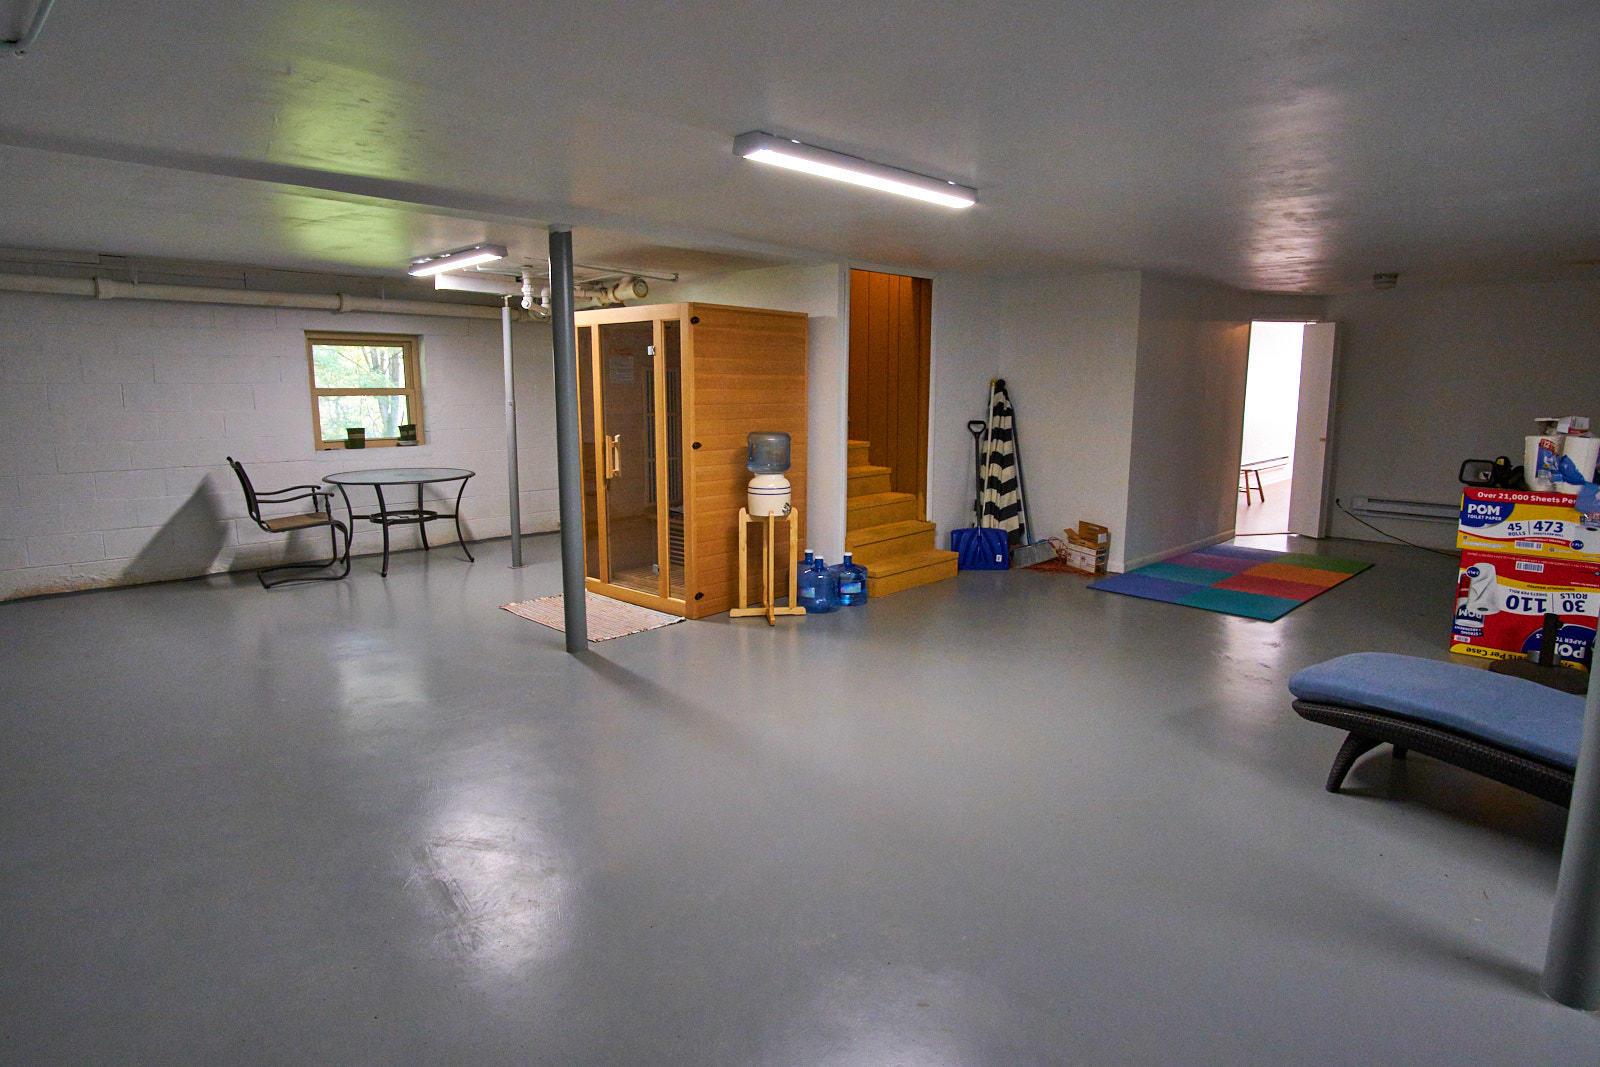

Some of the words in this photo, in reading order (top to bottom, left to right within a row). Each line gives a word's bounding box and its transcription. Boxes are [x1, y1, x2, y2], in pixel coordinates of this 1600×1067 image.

[1498, 493, 1529, 501] 21,000
[1530, 495, 1560, 504] Sheets
[1468, 504, 1500, 516] POM
[1508, 522, 1522, 531] 45
[1534, 520, 1564, 532] 473
[1506, 595, 1547, 613] 110
[1562, 600, 1585, 612] 30
[1564, 637, 1586, 645] PAPER
[1466, 647, 1488, 658] Case
